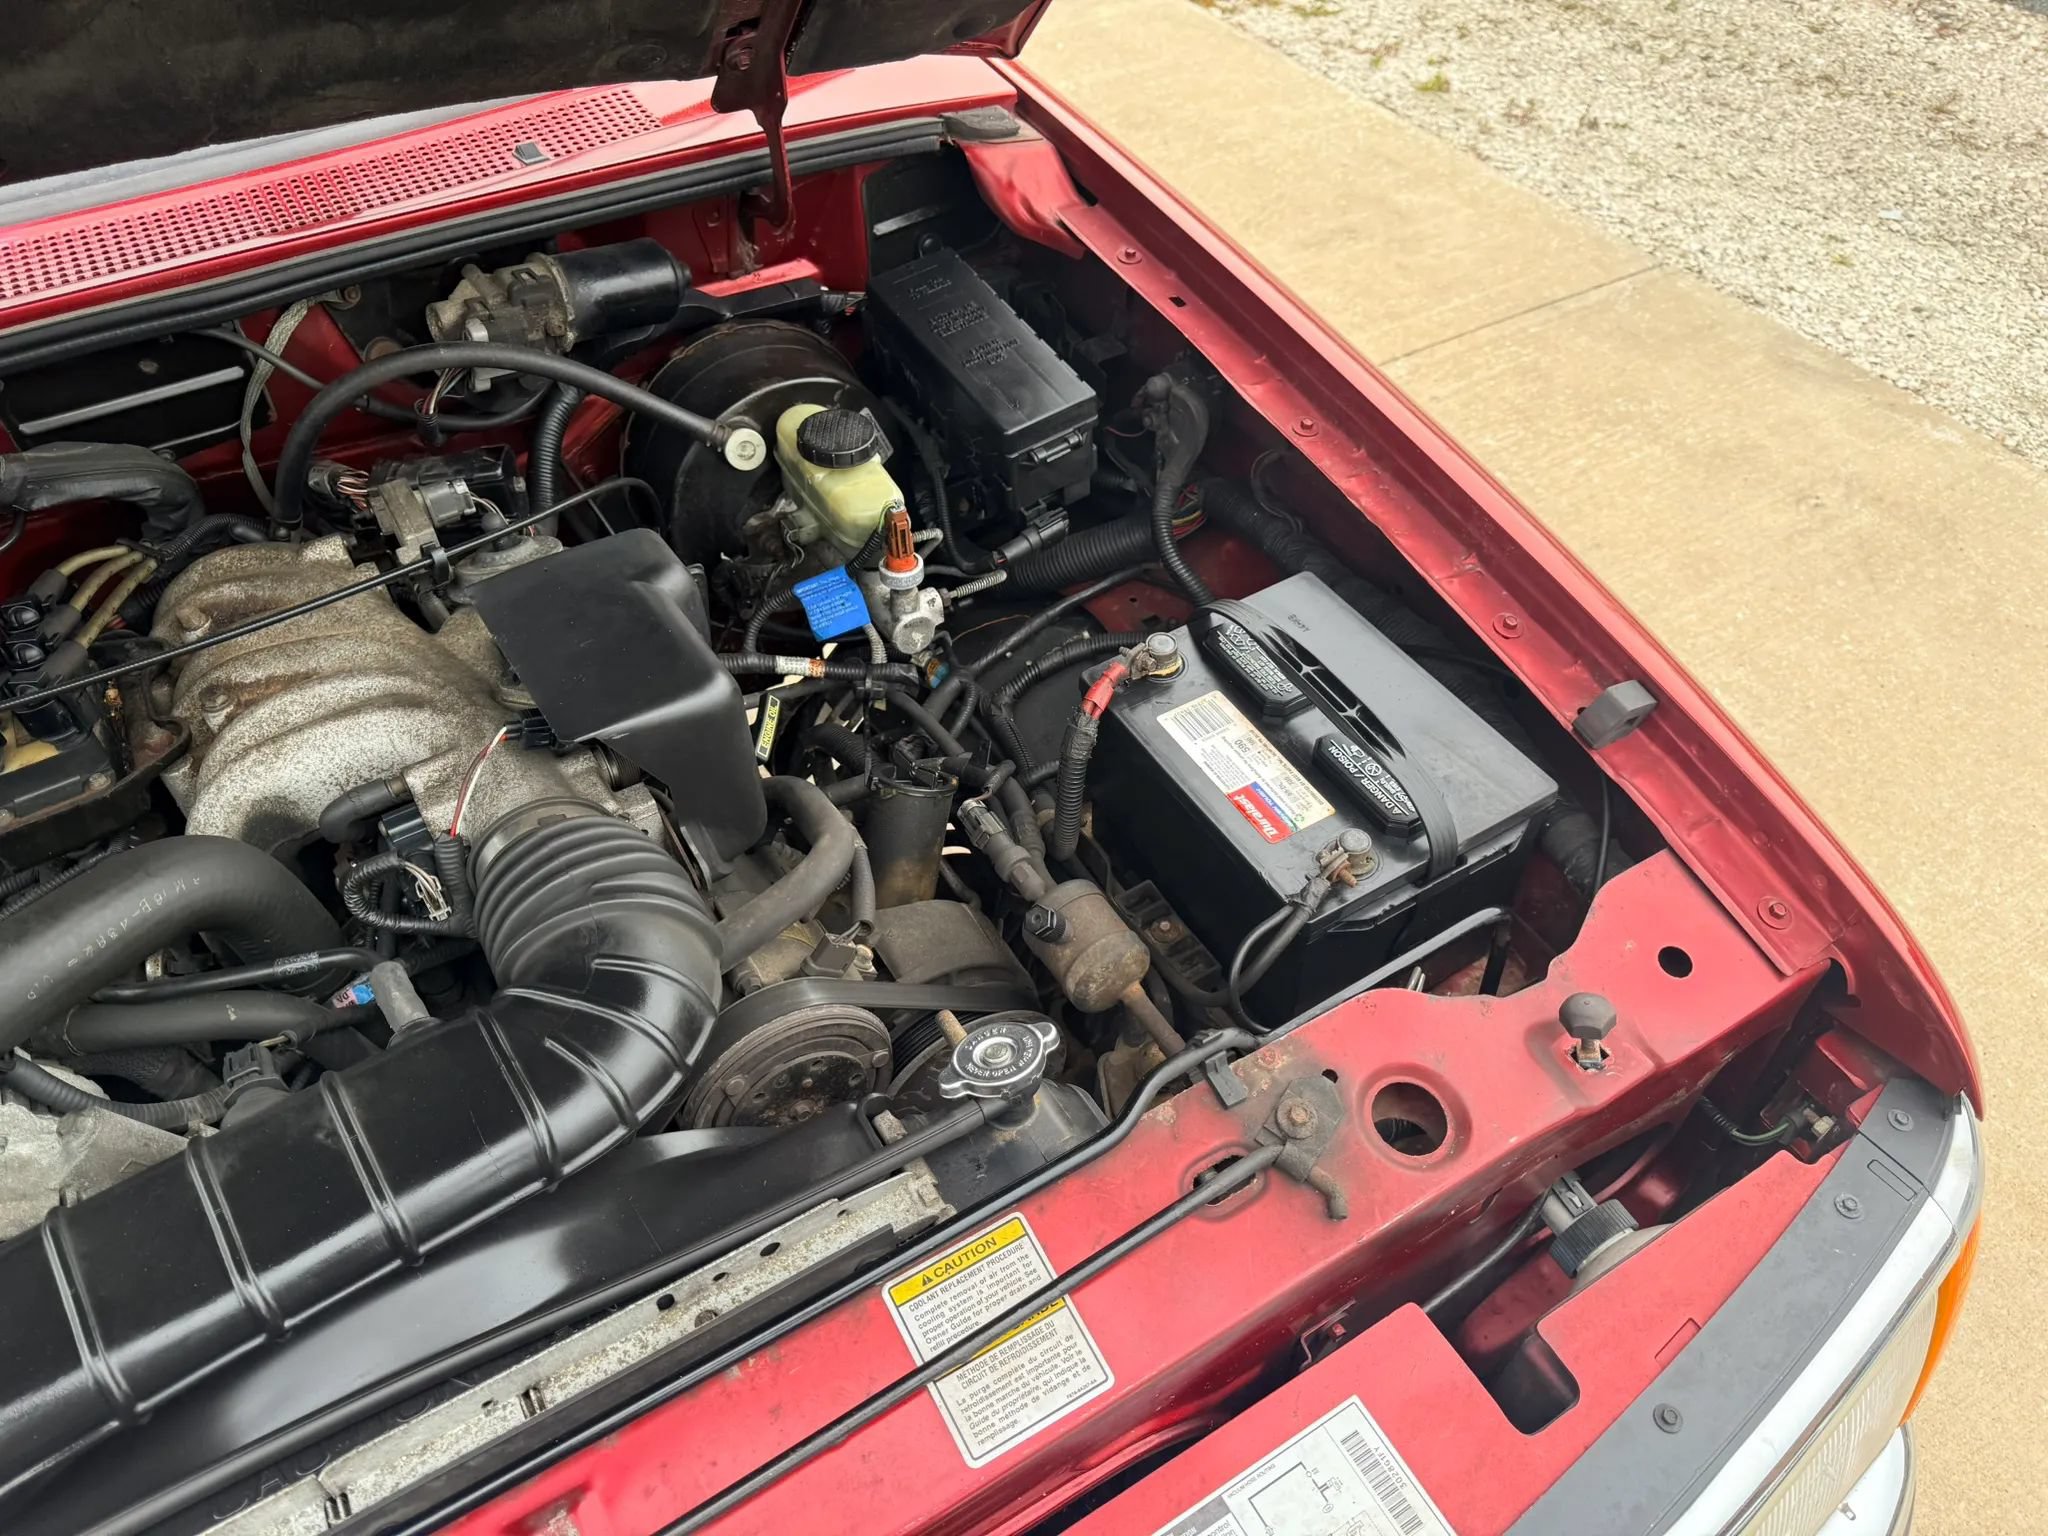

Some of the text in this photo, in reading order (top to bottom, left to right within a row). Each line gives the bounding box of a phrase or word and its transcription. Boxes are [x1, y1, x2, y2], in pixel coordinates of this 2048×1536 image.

[762, 703, 779, 748] ENGINE OIL
[1327, 743, 1358, 775] POISON
[1236, 793, 1279, 839] Duralast
[1360, 775, 1394, 811] DANGER
[907, 1241, 1024, 1312] COOLANT REPLACEMENT PROCEDURE
[913, 1252, 1029, 1322] Complete removal of air from the
[932, 1236, 997, 1278] CAUTION
[917, 1259, 1033, 1330] cooling system is important for
[920, 1266, 1038, 1338] proper operation of your vehicle. See
[924, 1326, 949, 1344] Owner
[949, 1313, 972, 1330] Guide
[971, 1306, 984, 1317] for
[983, 1293, 1009, 1312] proper
[1007, 1281, 1028, 1296] drain
[1027, 1273, 1042, 1285] and
[928, 1318, 982, 1352] refill procedure.
[960, 1327, 1059, 1390] CIRCUIT DE REFROIDISSEMENT
[967, 1382, 991, 1400] purge
[1026, 1354, 1038, 1365] du
[1038, 1339, 1063, 1357] circuit
[1063, 1332, 1074, 1343] de
[987, 1351, 999, 1363] DE
[998, 1325, 1045, 1357] REMPLISSAGE
[1042, 1318, 1055, 1330] DU
[959, 1340, 1079, 1415] refroidissement est importante pour
[963, 1413, 972, 1422] la
[971, 1400, 995, 1418] bonne
[994, 1384, 1020, 1404] marche
[1019, 1378, 1031, 1389] du
[1060, 1351, 1075, 1364] Voir
[1073, 1347, 1083, 1356] le
[967, 1412, 991, 1430] Guide
[989, 1406, 1001, 1417] du
[1040, 1375, 1054, 1388] qui
[1052, 1360, 1080, 1380] indique
[1077, 1355, 1087, 1364] la
[971, 1420, 996, 1438] bonne
[996, 1400, 1029, 1423] méthode
[1029, 1393, 1041, 1404] de
[1041, 1375, 1071, 1398] vidange
[1071, 1369, 1081, 1379] et
[1080, 1362, 1092, 1373] de
